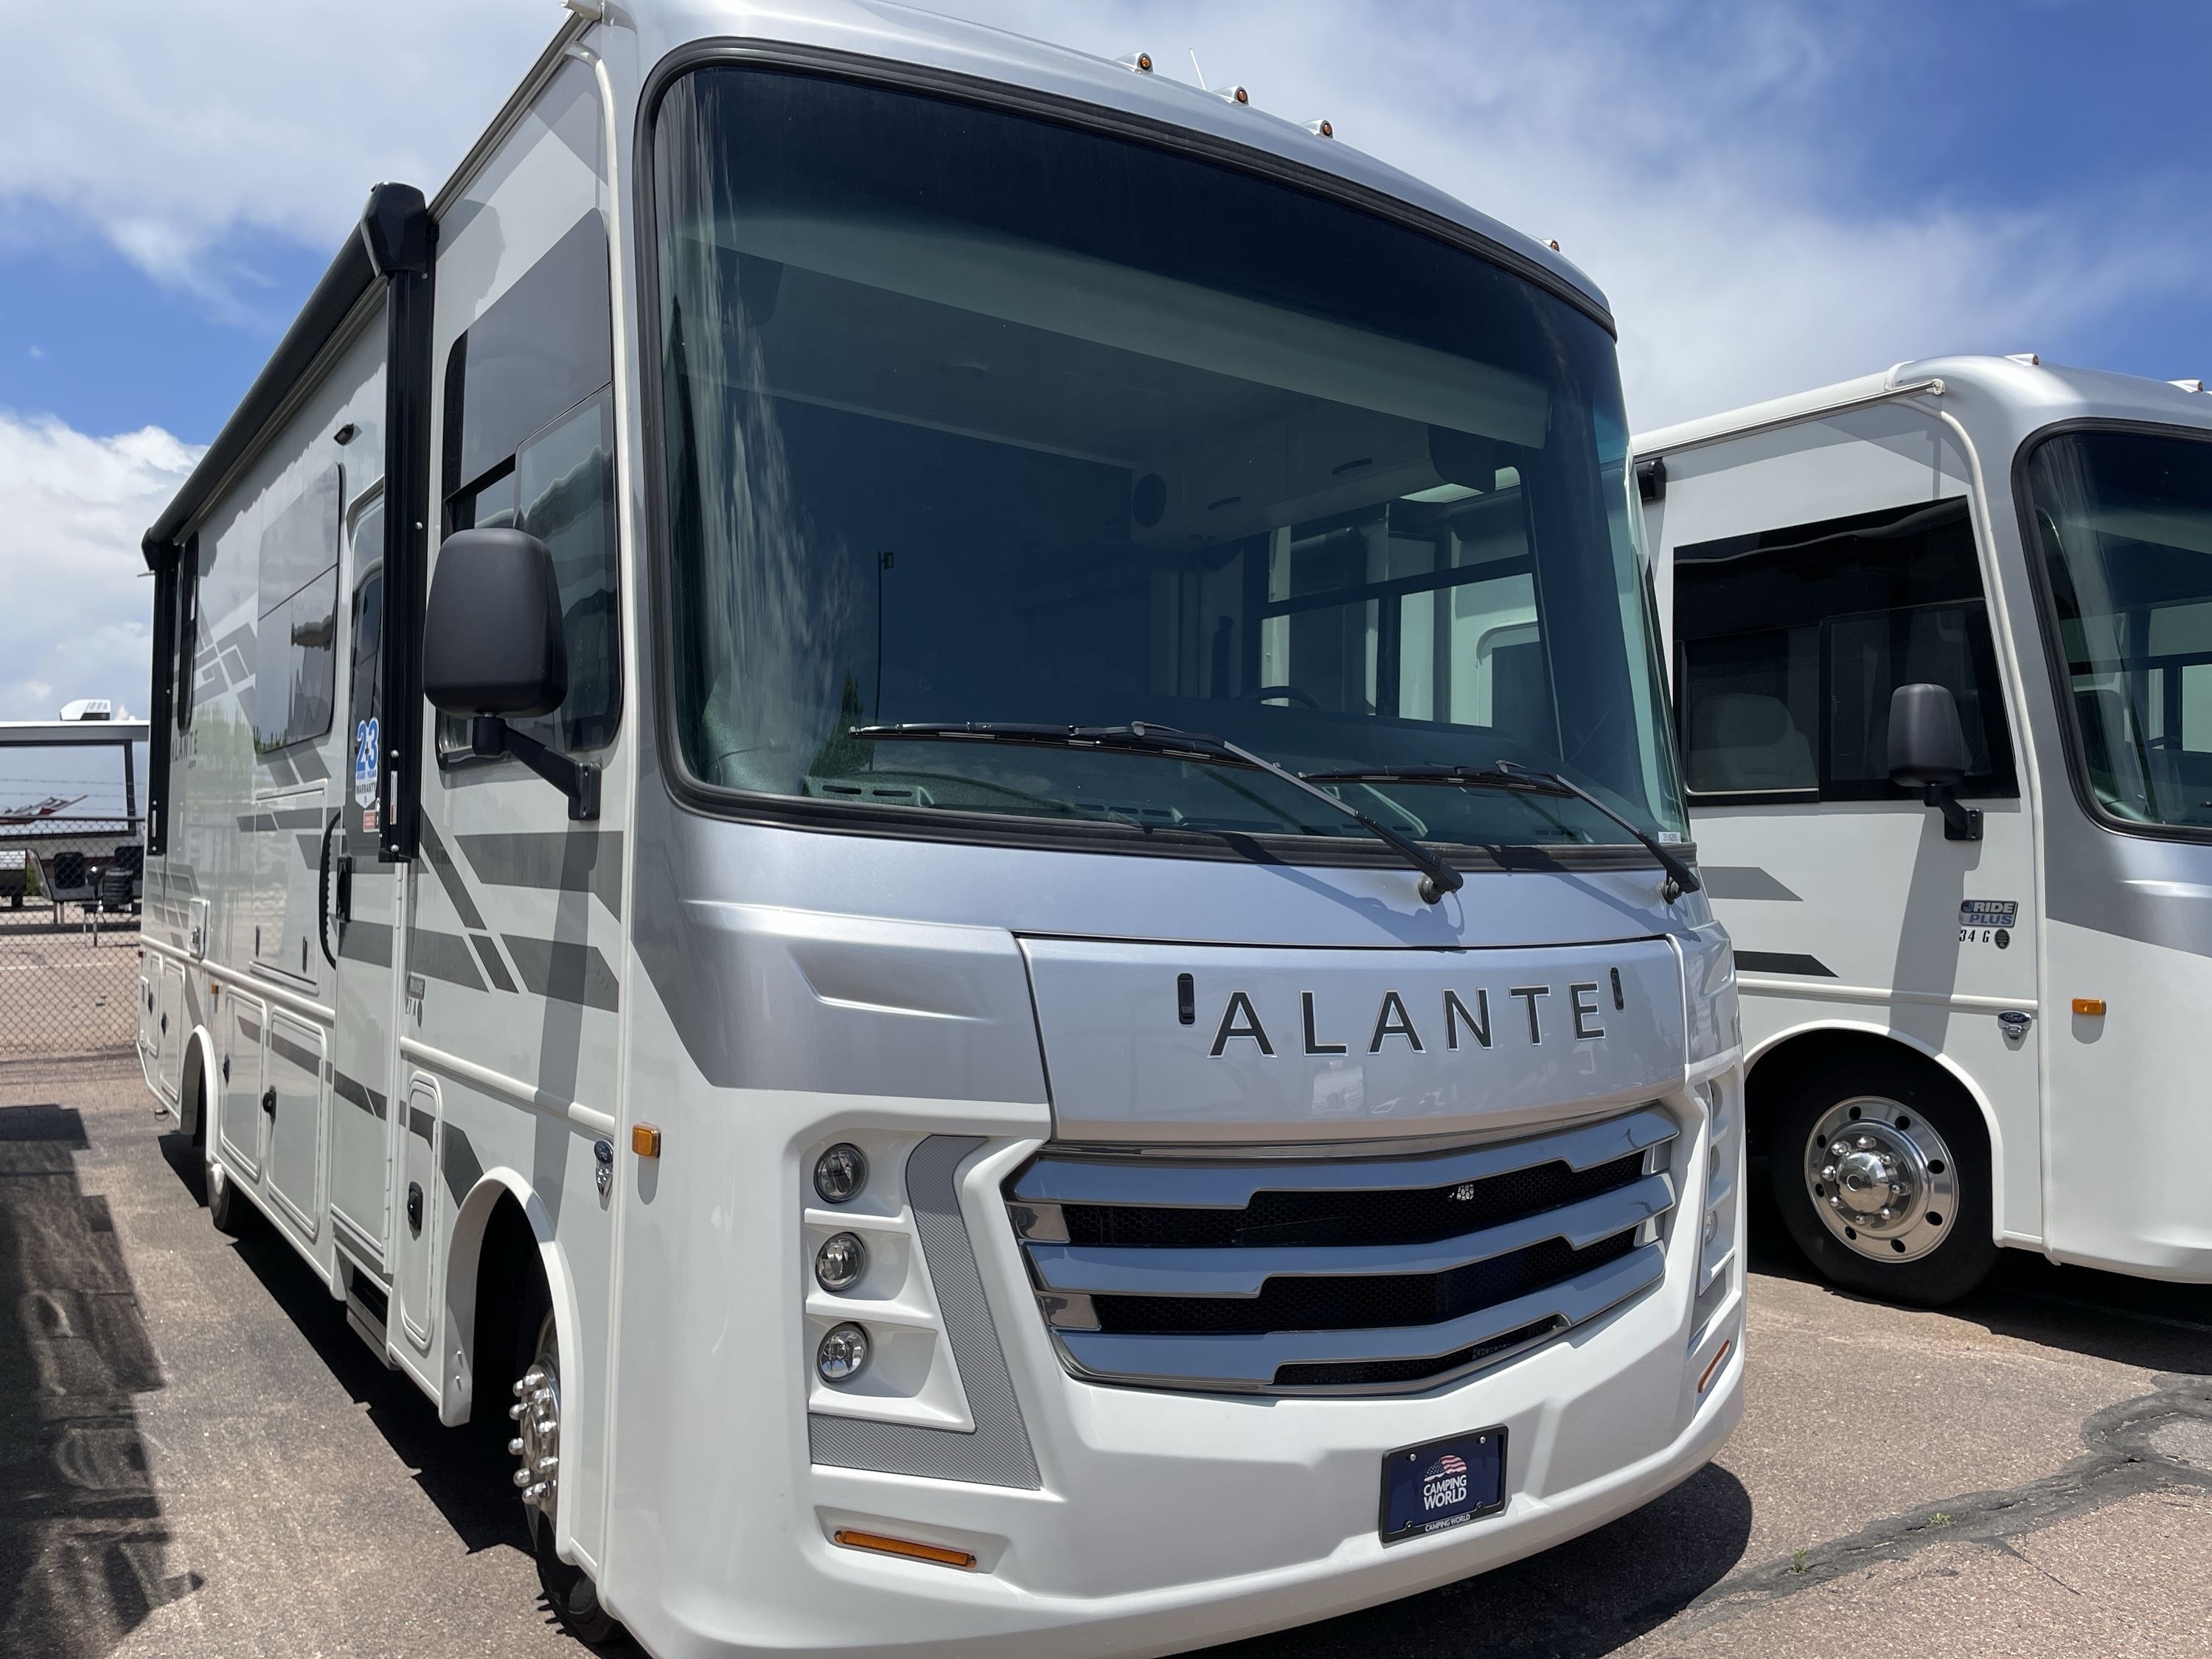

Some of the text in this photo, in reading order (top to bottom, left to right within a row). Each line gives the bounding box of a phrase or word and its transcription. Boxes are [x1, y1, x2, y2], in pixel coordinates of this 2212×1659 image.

[171, 729, 198, 762] ALANTE
[1969, 914, 2013, 925] PLUS
[1958, 928, 1975, 942] 34
[1981, 930, 1991, 943] G
[1207, 981, 1607, 1060] ALANTE
[1424, 1474, 1467, 1496] CAMPING
[1424, 1486, 1467, 1510] WORLD
[1425, 1514, 1471, 1532] CAMPING WORLD
